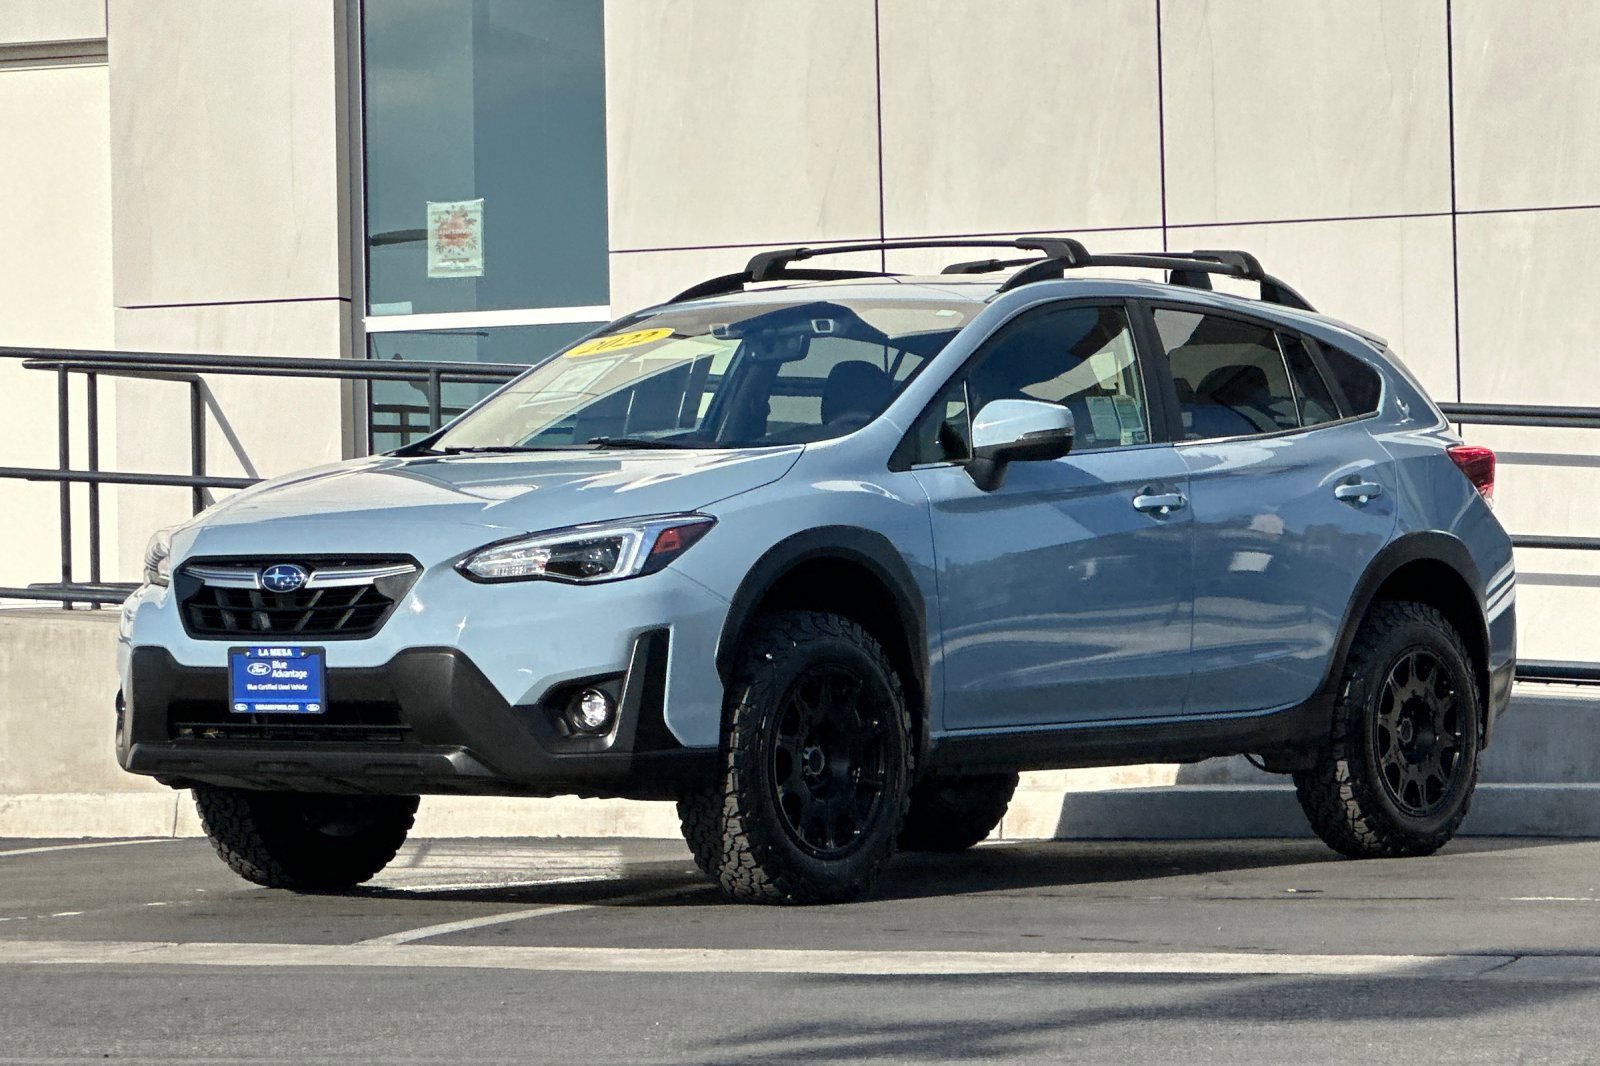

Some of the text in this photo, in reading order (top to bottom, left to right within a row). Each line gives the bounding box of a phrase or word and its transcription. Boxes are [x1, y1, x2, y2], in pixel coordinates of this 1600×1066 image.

[258, 649, 293, 657] LA MESA
[272, 660, 287, 669] Blue
[272, 670, 308, 679] Advantage
